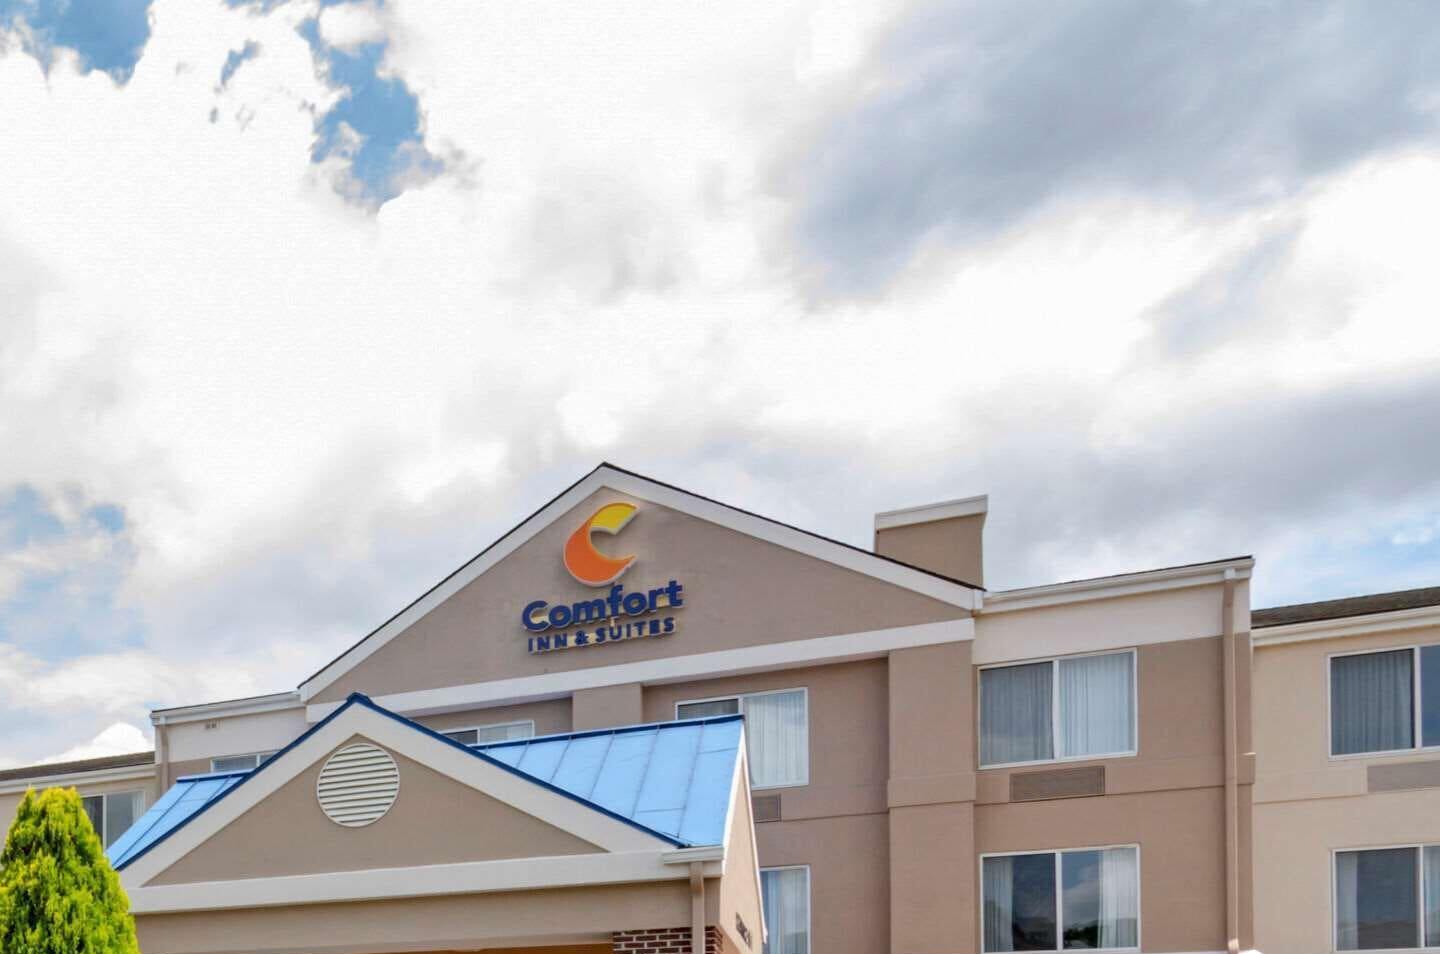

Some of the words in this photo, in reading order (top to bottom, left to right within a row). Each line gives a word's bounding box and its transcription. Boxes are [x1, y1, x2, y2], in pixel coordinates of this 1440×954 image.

[522, 579, 685, 632] Comfort
[527, 632, 568, 653] INN
[574, 630, 590, 645] &
[595, 616, 676, 644] SUITES
